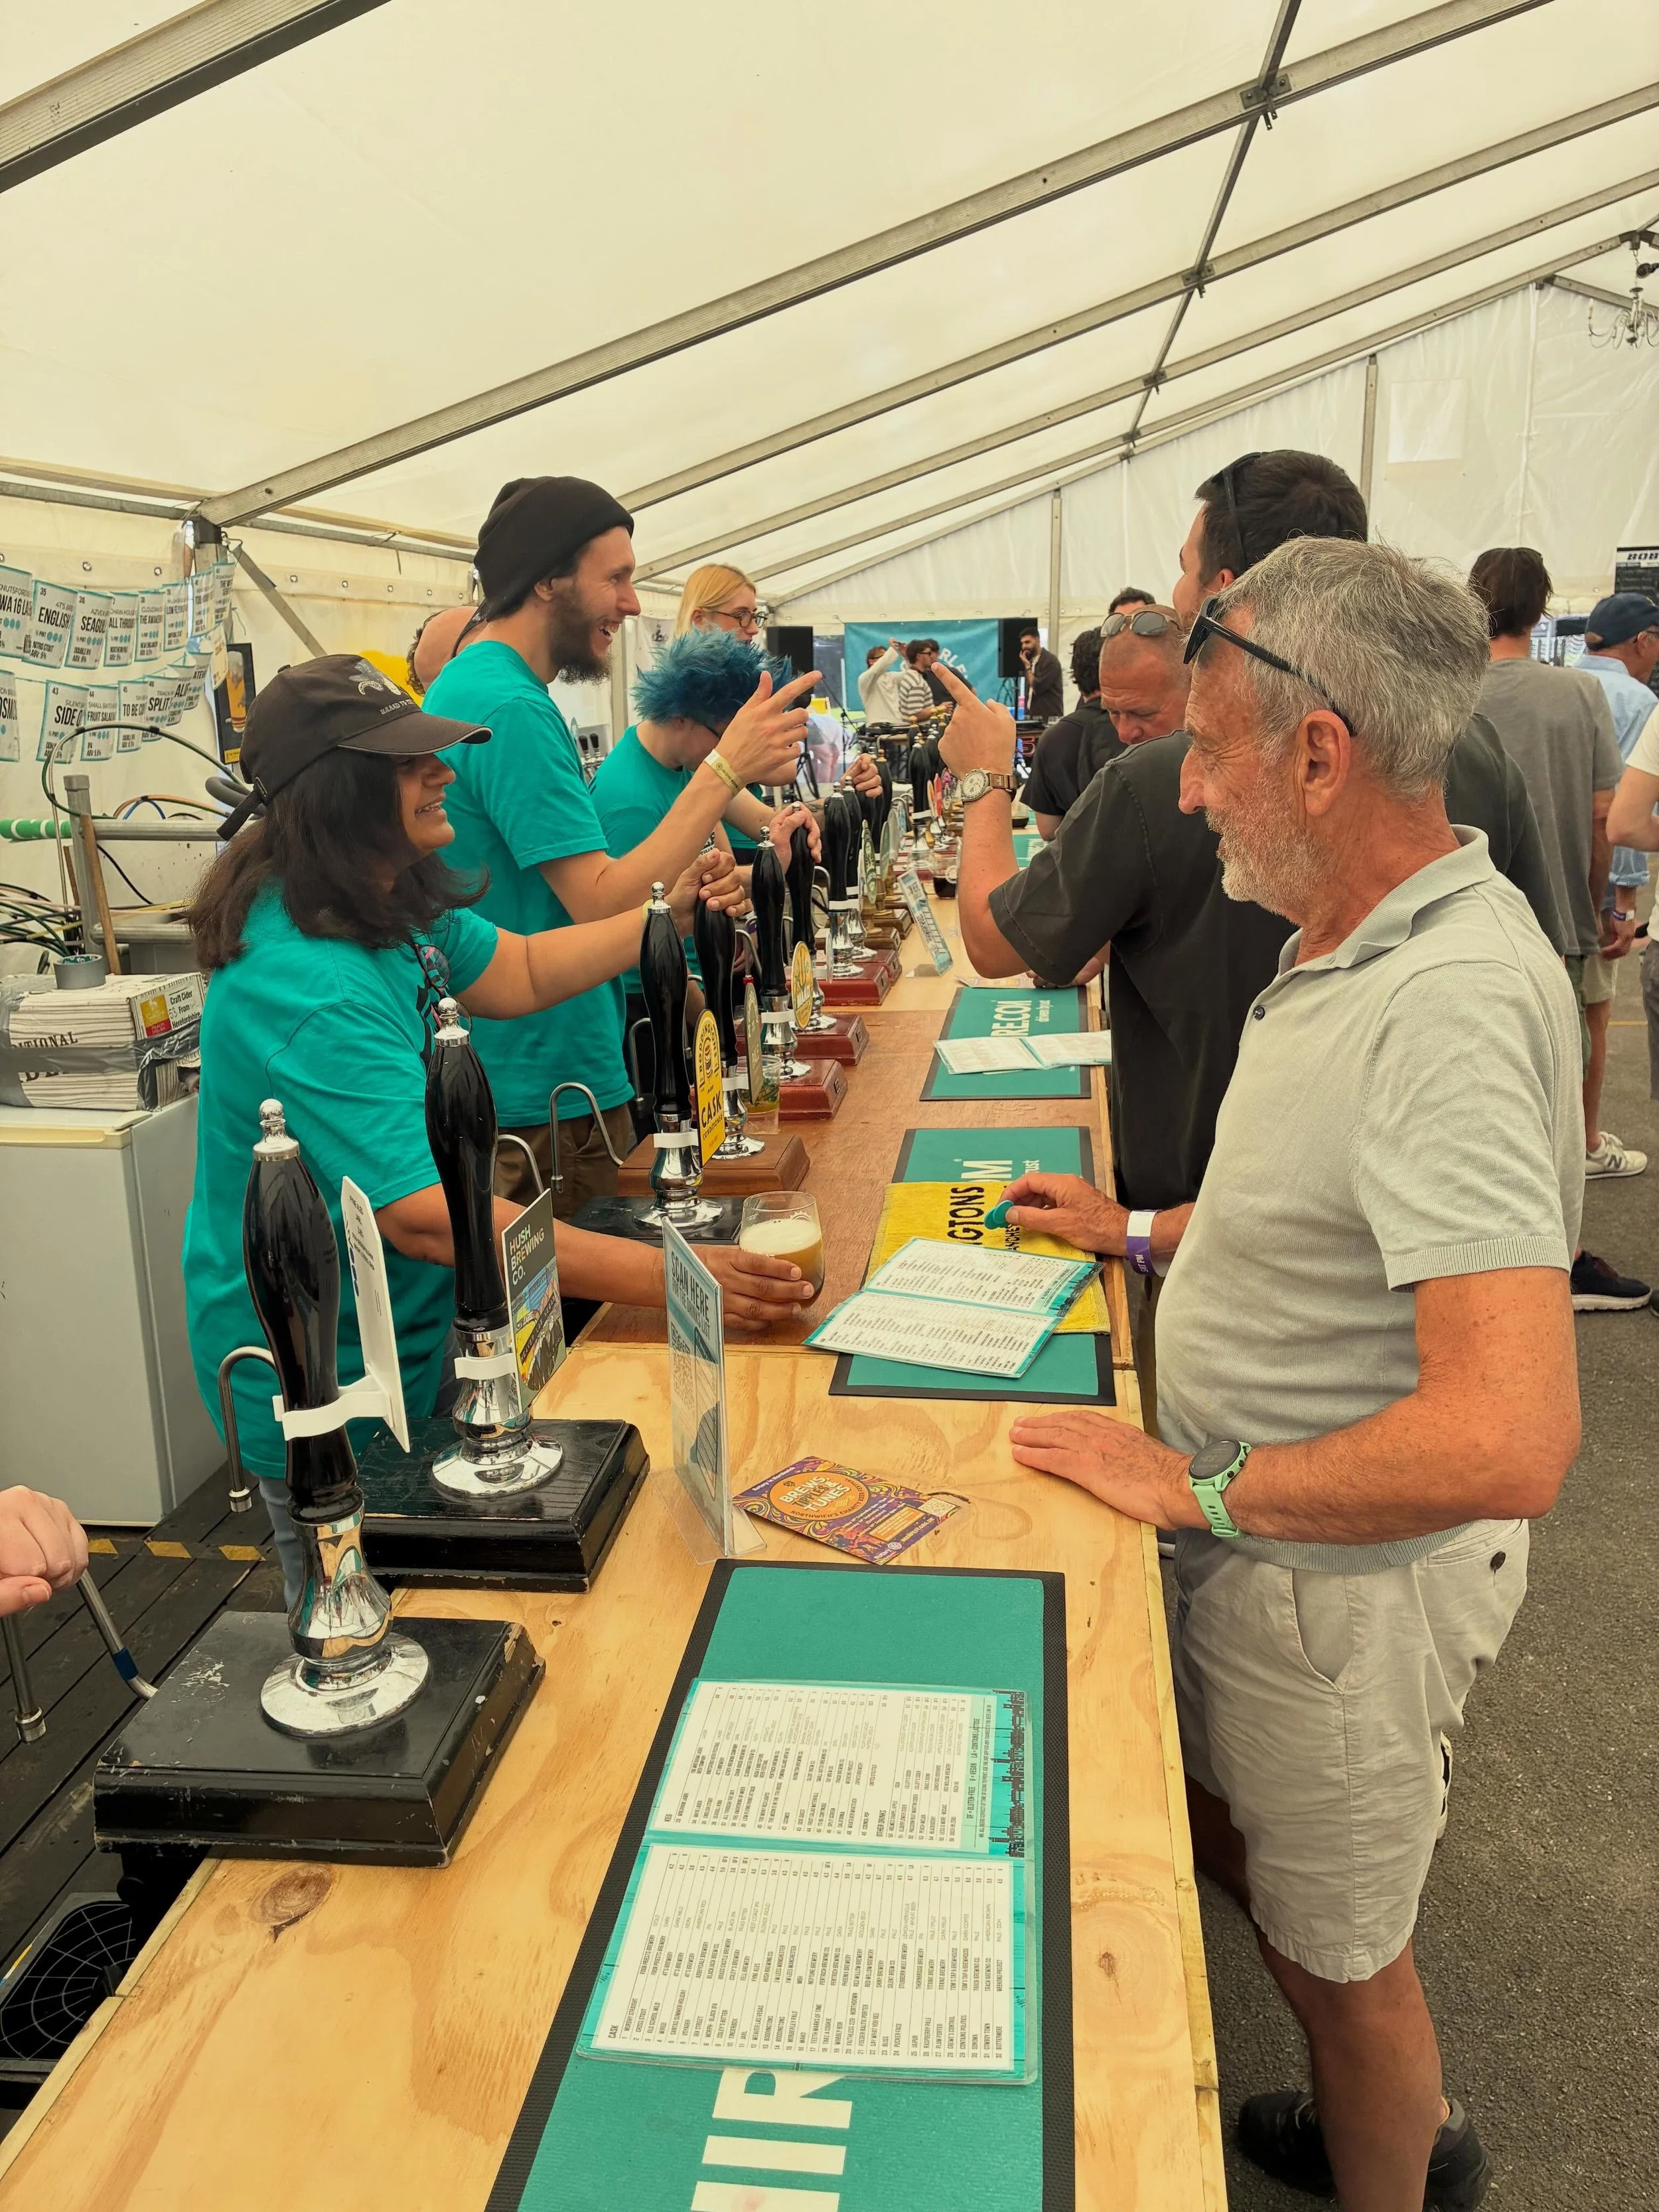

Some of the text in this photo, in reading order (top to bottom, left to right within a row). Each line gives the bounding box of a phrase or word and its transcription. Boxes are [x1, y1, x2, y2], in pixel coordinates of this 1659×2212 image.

[40, 587, 46, 596] 35
[52, 687, 59, 696] 43
[148, 697, 170, 711] SPLIT
[54, 705, 76, 726] SIDE
[170, 995, 182, 1005] Craft
[179, 1004, 190, 1014] From
[173, 1012, 200, 1029] Herefordshire
[701, 1090, 722, 1128] CASK
[510, 1224, 532, 1252] HUSH
[511, 1228, 544, 1270] BREWING
[512, 1266, 526, 1286] CO.
[672, 1251, 710, 1321] SCAN HERE
[687, 1299, 701, 1327] DRINKS
[789, 1485, 833, 1508] TIPPLES
[800, 1483, 855, 1513] TUNES
[607, 2024, 619, 2038] CASK
